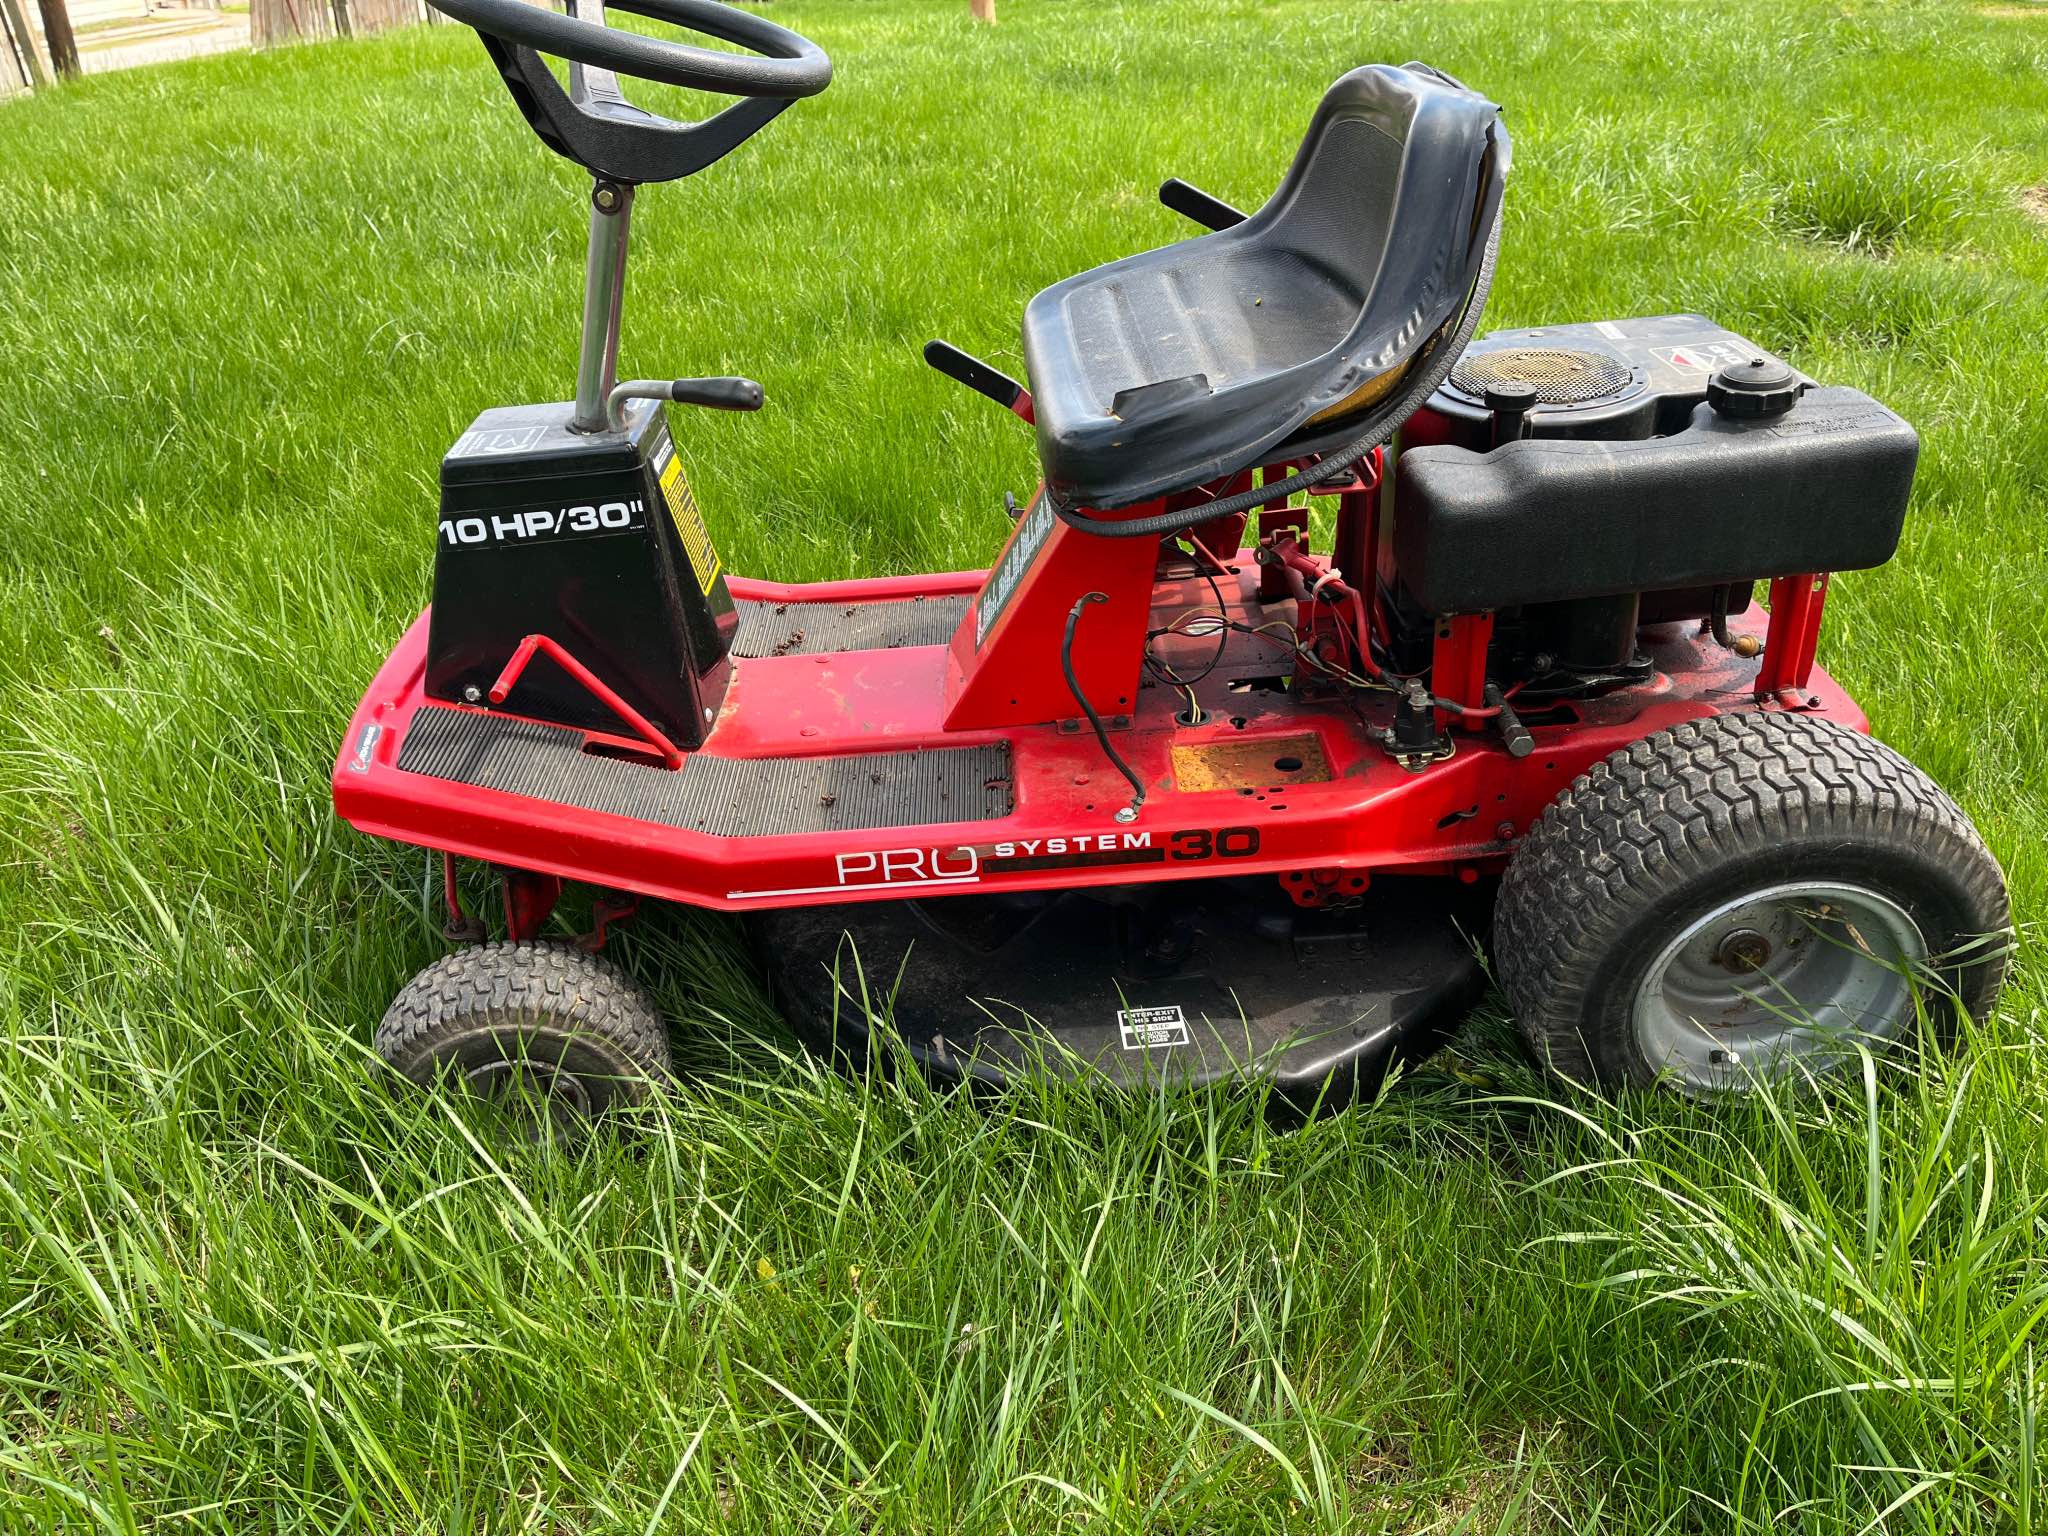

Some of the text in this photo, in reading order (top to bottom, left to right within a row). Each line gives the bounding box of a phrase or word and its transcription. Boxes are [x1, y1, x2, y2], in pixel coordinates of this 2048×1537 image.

[439, 518, 488, 545] 10
[835, 826, 1260, 884] PRO SYSTEM 30
